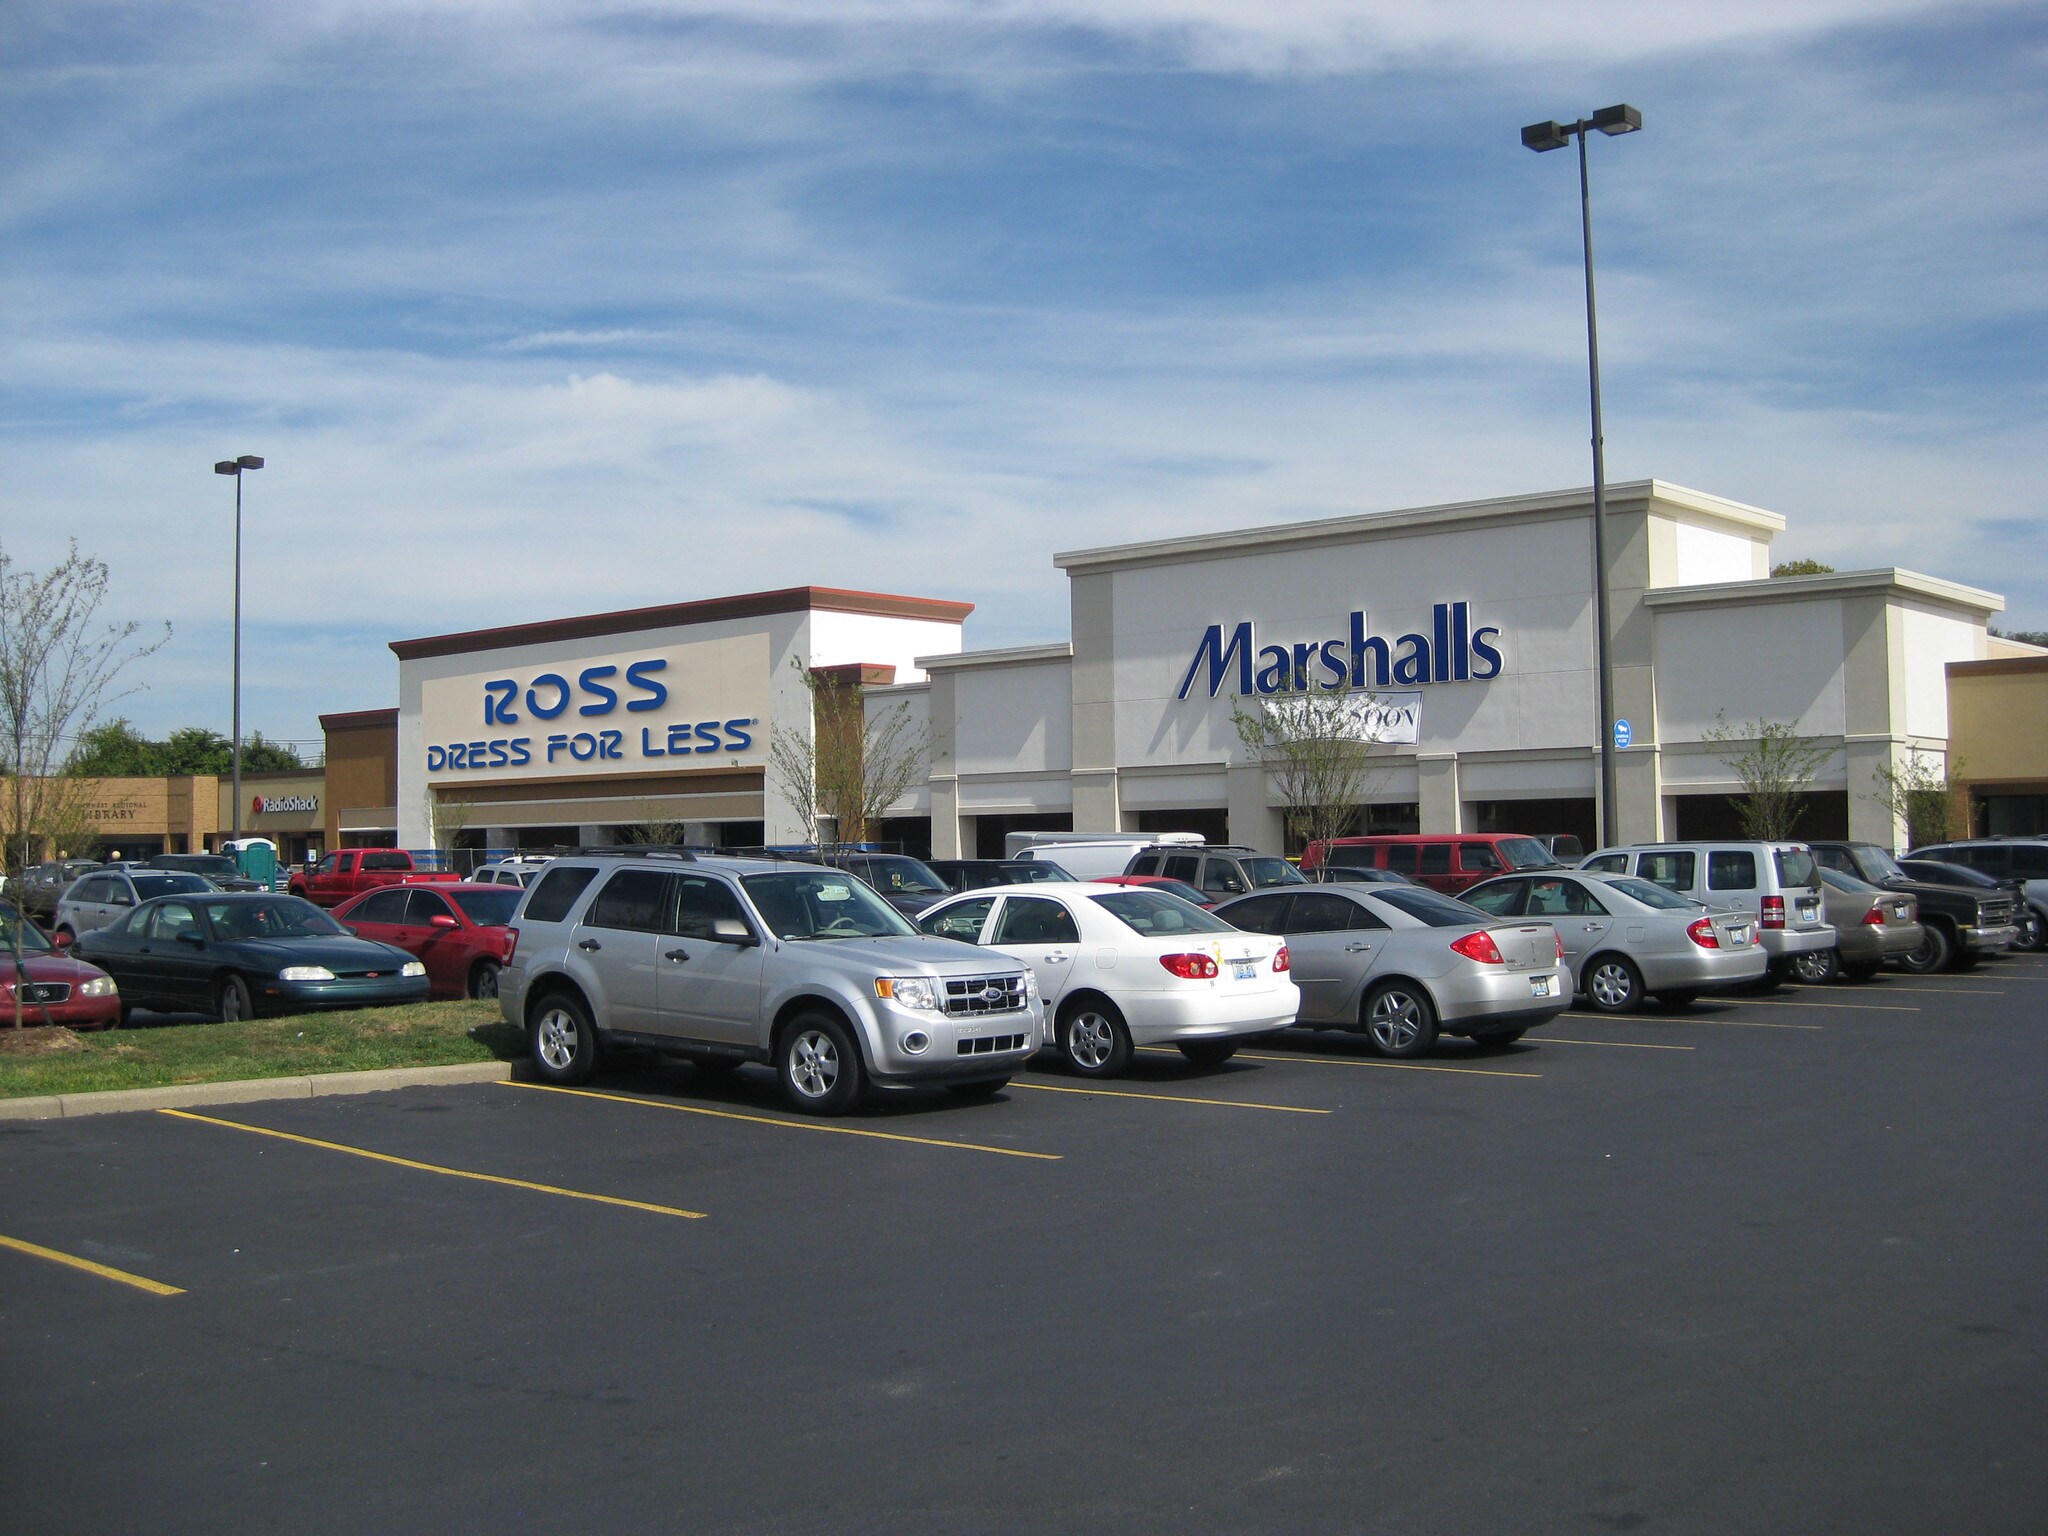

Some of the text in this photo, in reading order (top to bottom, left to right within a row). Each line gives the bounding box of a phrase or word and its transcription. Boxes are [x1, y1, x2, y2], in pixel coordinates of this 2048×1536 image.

[1177, 601, 1505, 700] Marshalls
[484, 659, 668, 725] ROSS
[427, 737, 530, 771] DRESS
[547, 729, 623, 763] FOR
[81, 809, 137, 820] LIBRARY
[263, 795, 318, 813] RadioShack
